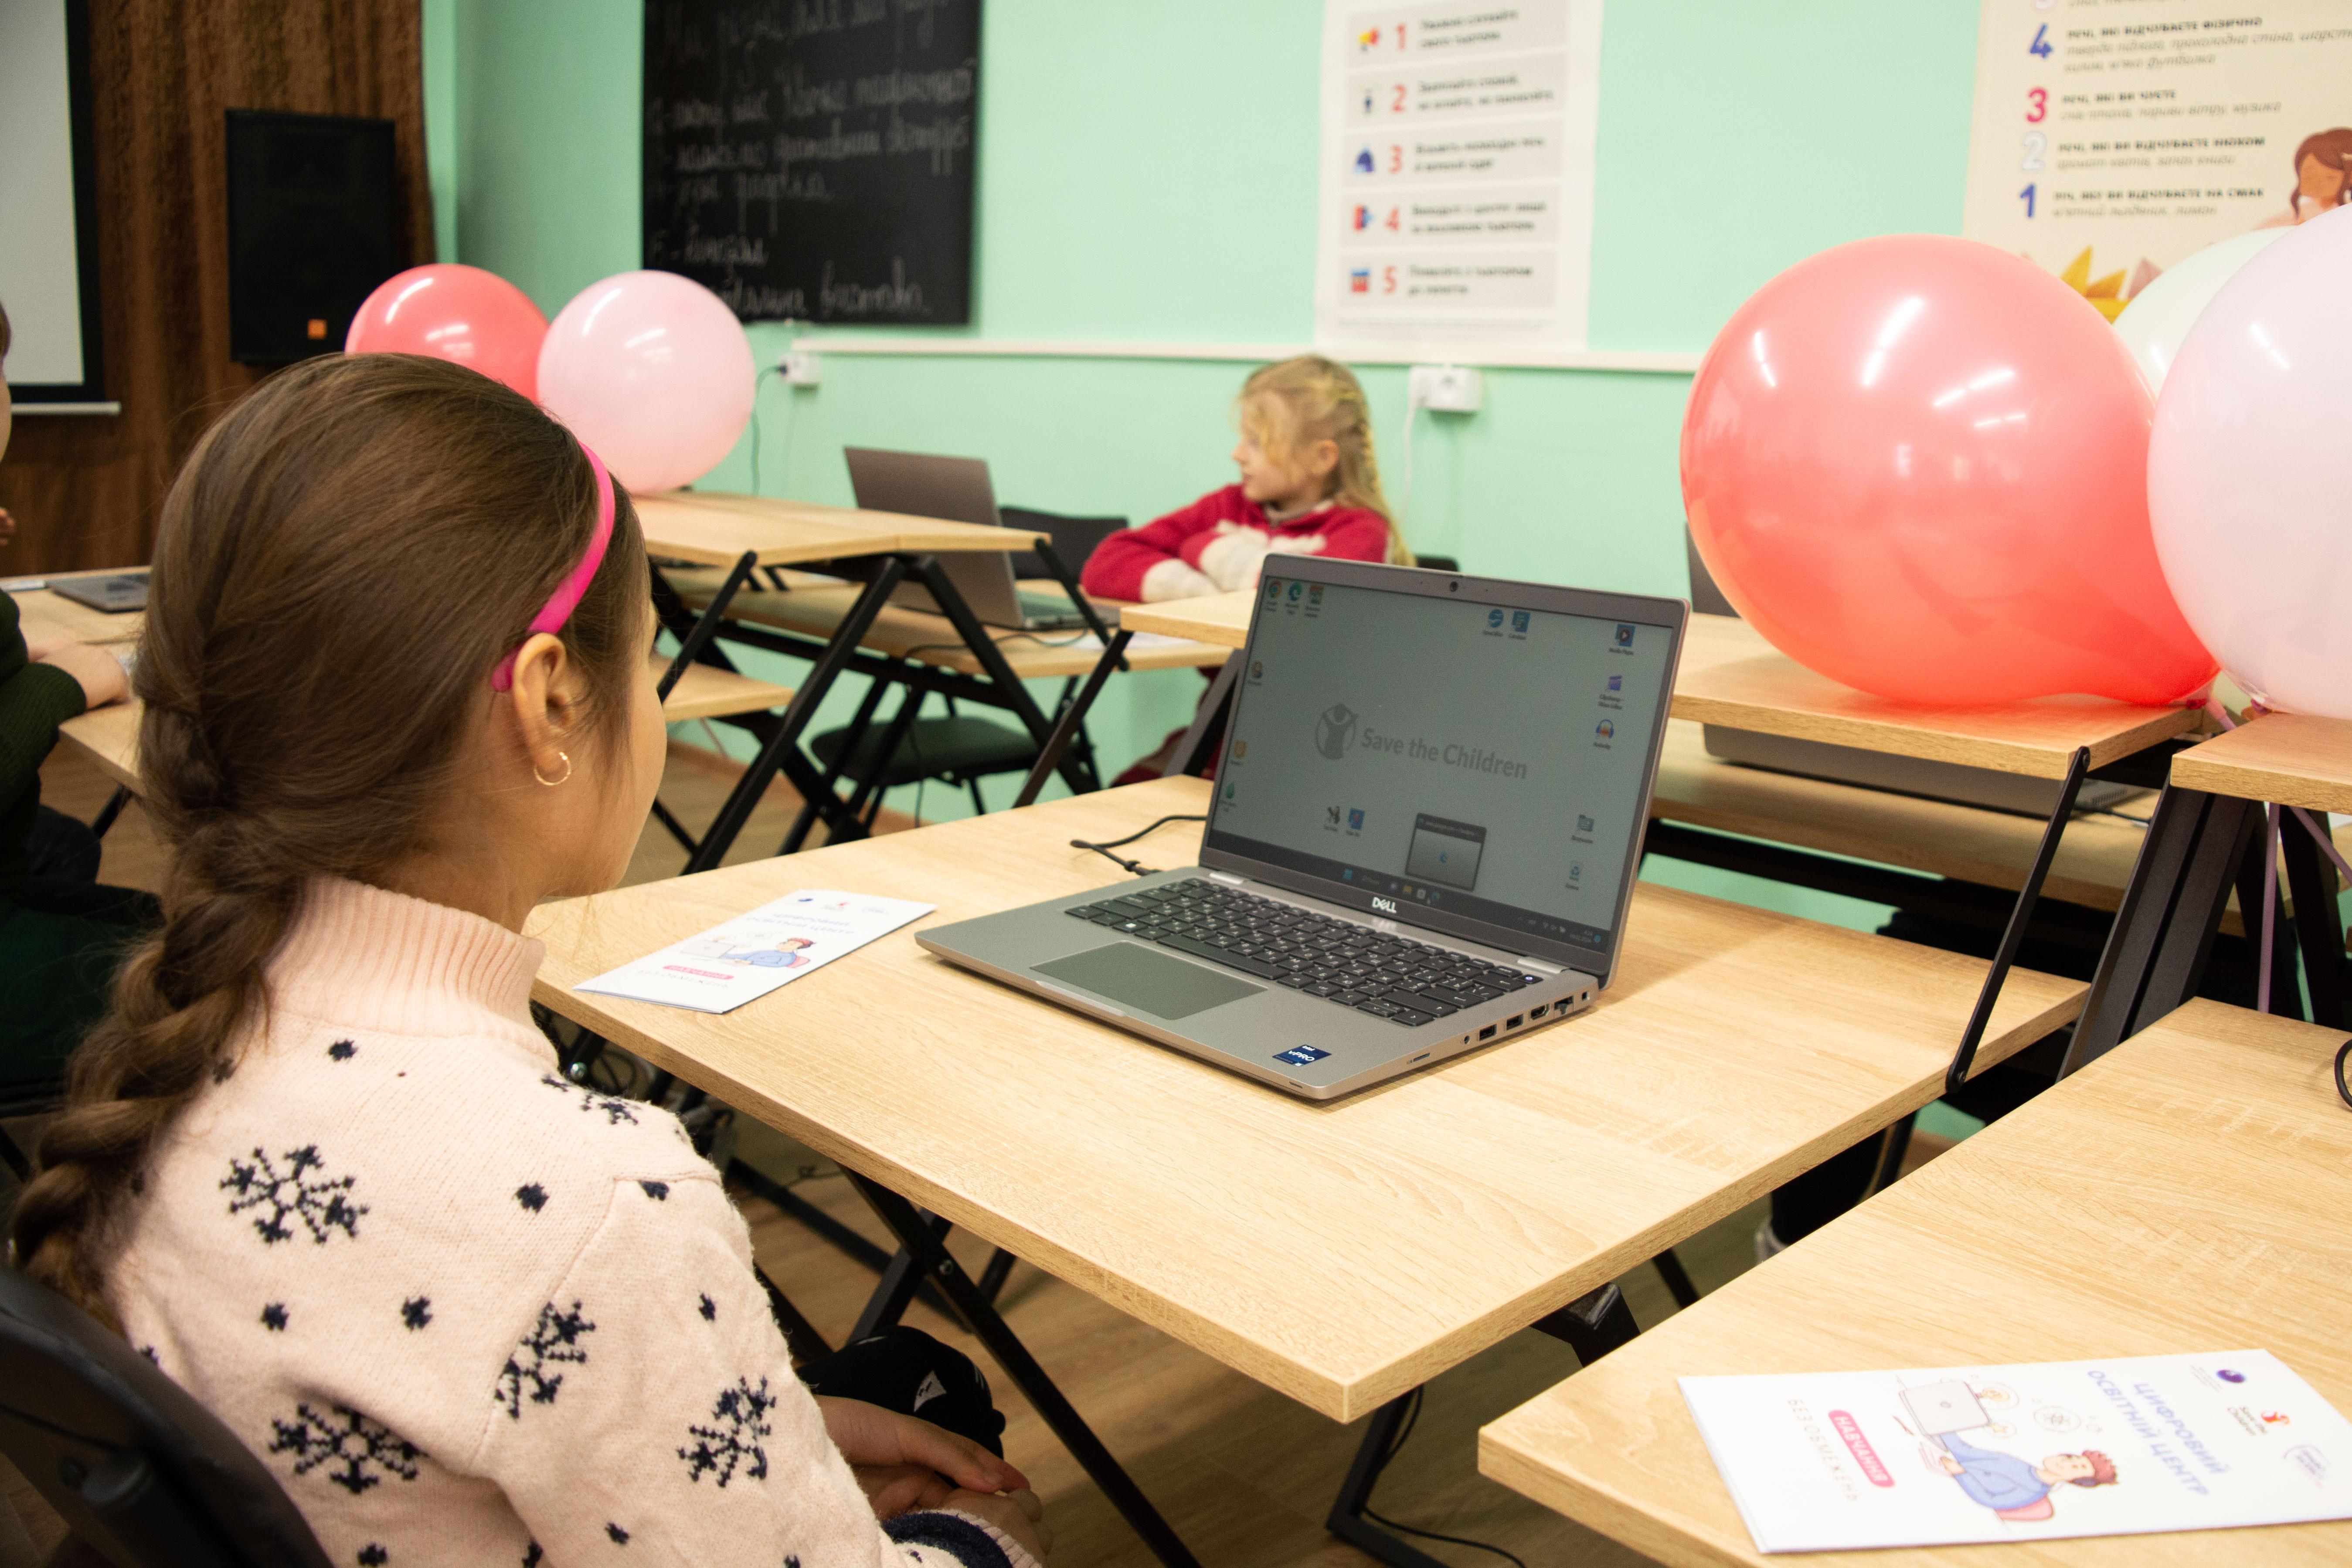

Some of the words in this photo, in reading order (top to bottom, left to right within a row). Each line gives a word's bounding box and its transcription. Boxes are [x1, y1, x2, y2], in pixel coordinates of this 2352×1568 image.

[1395, 24, 1407, 51] 1
[2029, 23, 2054, 58] 4
[1391, 84, 1407, 112] 2
[2026, 88, 2048, 123] 3
[1389, 145, 1404, 173] 3
[2019, 130, 2047, 171] 2
[2019, 182, 2036, 218] 1
[2227, 187, 2264, 197] СМАК
[1385, 205, 1400, 232] 4
[1383, 265, 1397, 294] 5
[1361, 727, 1404, 755] Save
[1408, 738, 1438, 762] the
[1443, 743, 1526, 779] Children
[1371, 896, 1397, 913] DELL
[1288, 1050, 1315, 1061] vPRO
[2087, 1370, 2162, 1438] ОСВІТНІЙ
[2150, 1443, 2209, 1495] ЦЕНТР
[2133, 1383, 2231, 1473] ЦИФРОВИЙ
[1788, 1399, 1813, 1421] БЕЗ
[1804, 1424, 1861, 1501] ОБМЕЖЕНЬ
[1833, 1416, 1890, 1482] НАВЧАННЯ
